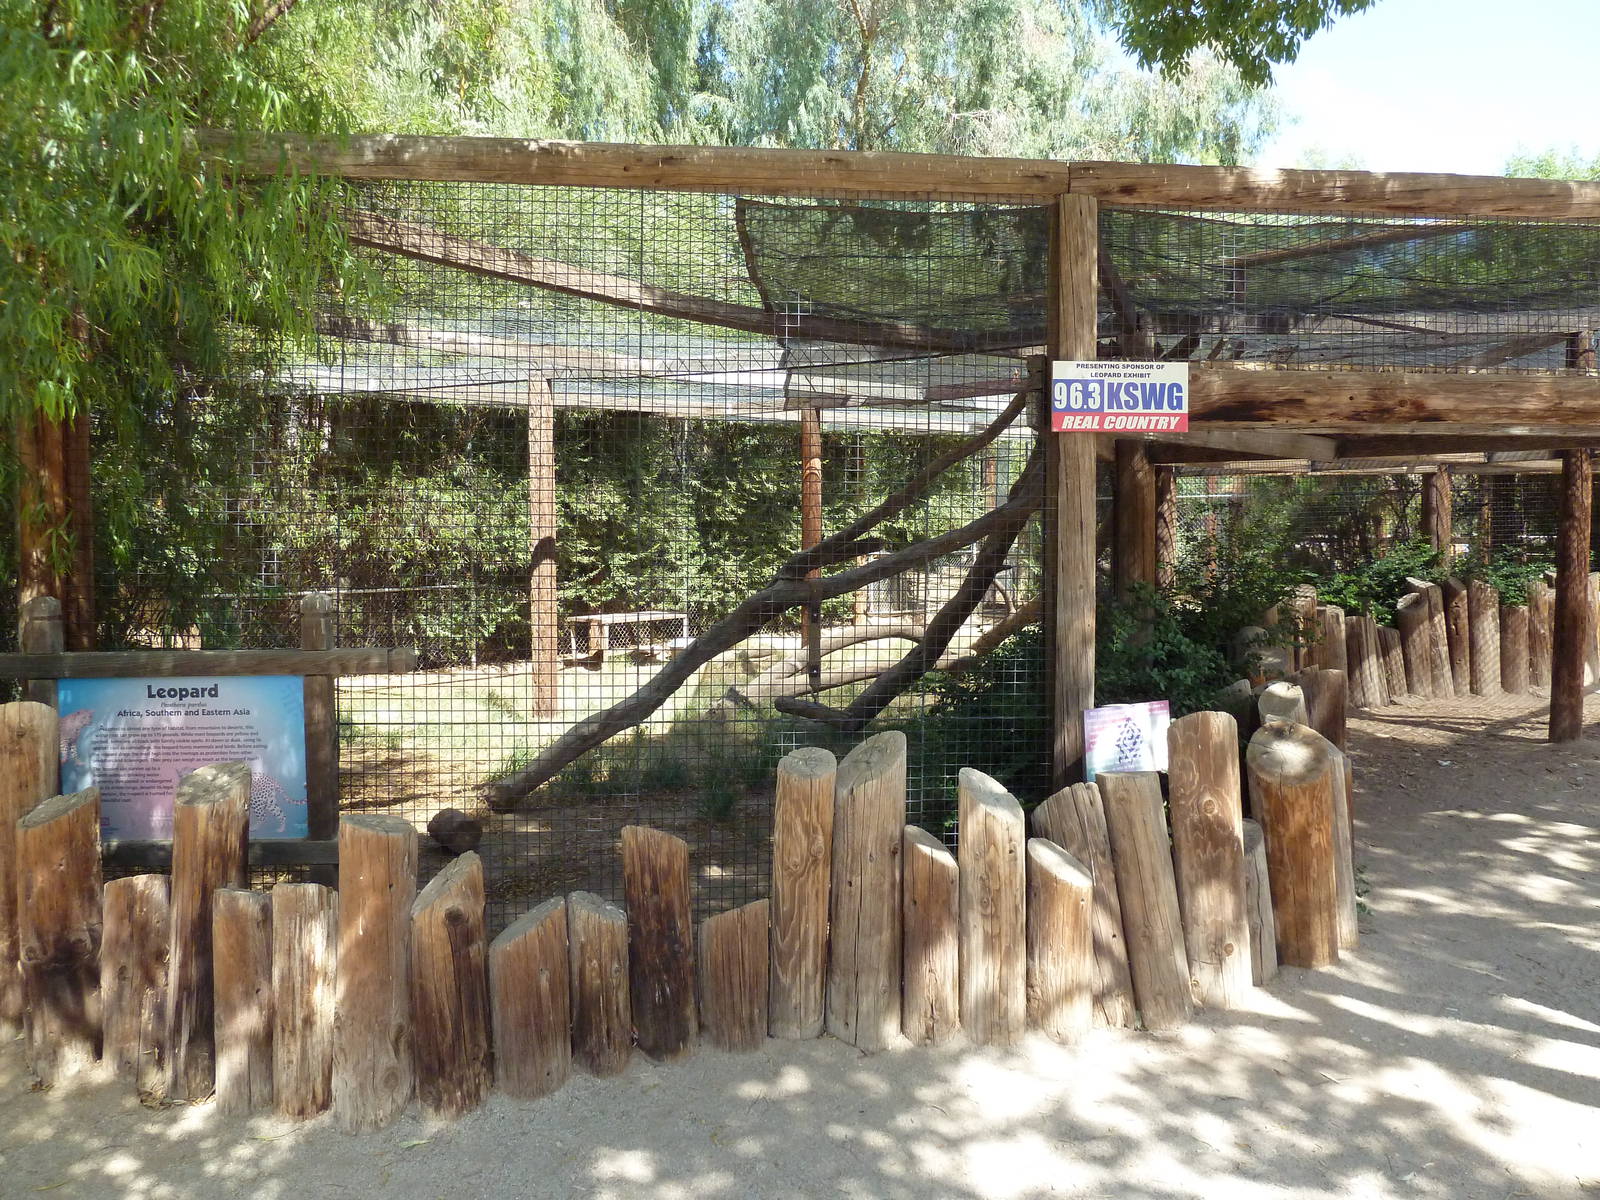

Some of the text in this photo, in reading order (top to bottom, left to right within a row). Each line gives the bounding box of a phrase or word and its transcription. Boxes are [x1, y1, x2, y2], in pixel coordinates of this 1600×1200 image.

[1054, 382, 1184, 410] 96.3 KSWG
[1062, 415, 1180, 430] REAL COUNTRY
[147, 683, 219, 701] Leopard
[117, 707, 251, 718] Africa, Southern and Eastern Asia
